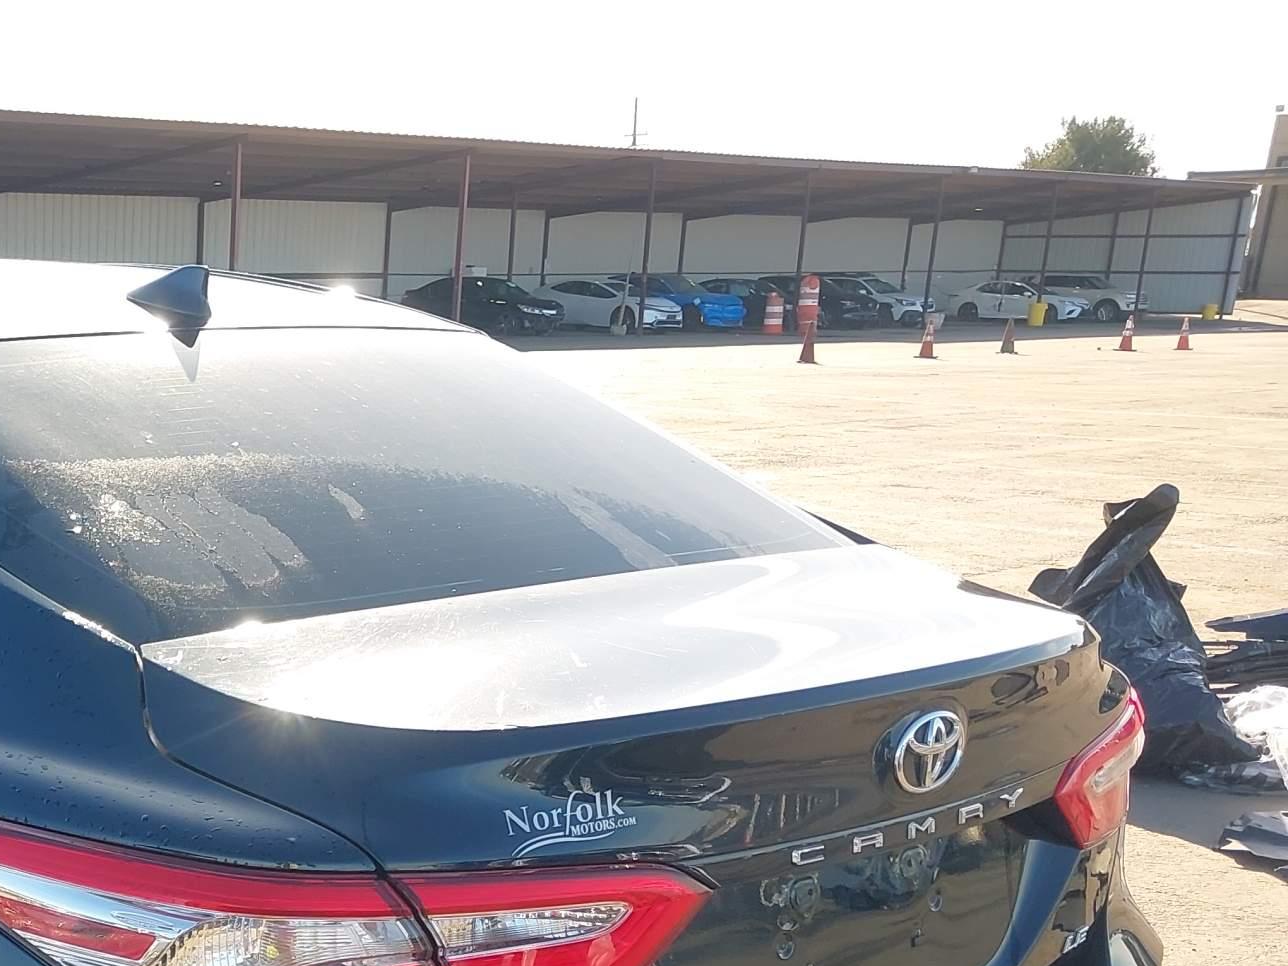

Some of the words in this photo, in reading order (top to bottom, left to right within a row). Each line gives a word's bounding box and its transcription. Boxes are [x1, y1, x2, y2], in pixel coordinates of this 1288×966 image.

[503, 789, 625, 836] Norfolk
[570, 816, 637, 837] MOTORS.COM
[791, 787, 1024, 867] CAMRY
[1062, 926, 1090, 955] LE
